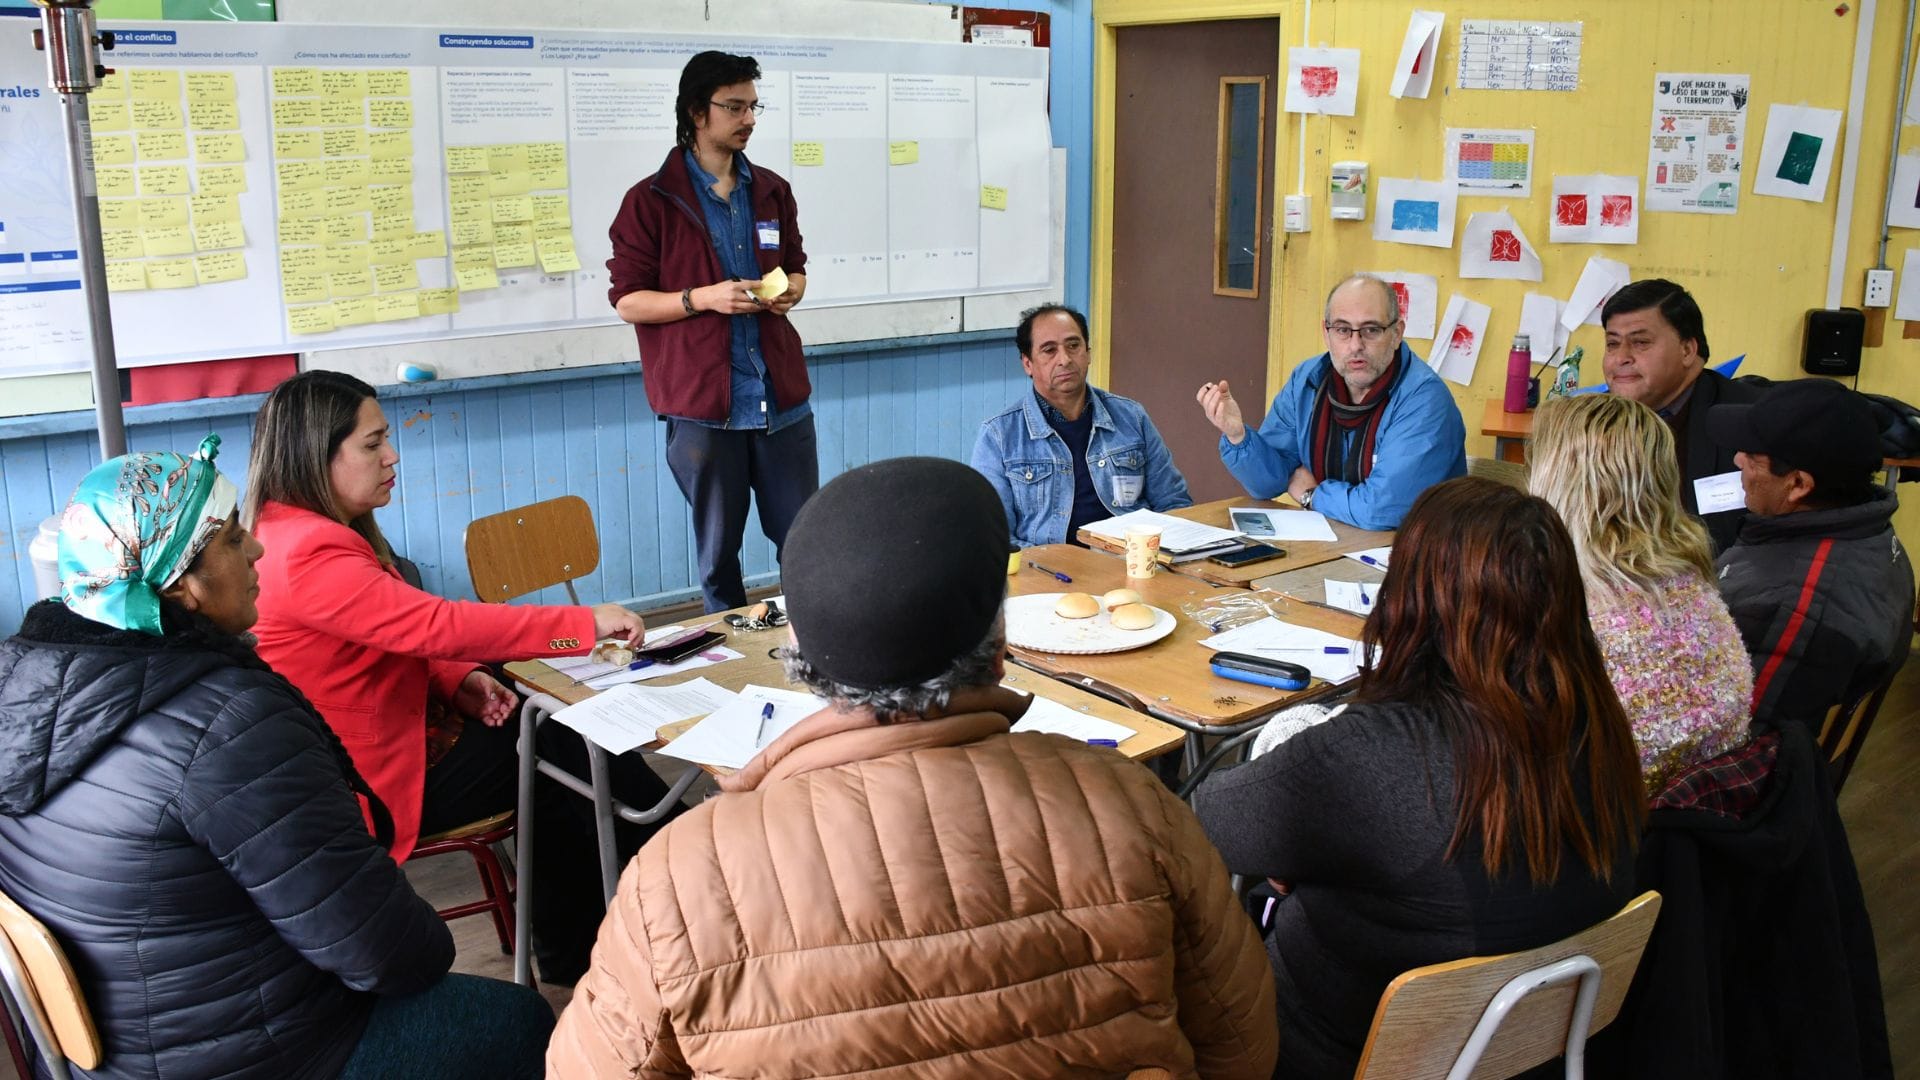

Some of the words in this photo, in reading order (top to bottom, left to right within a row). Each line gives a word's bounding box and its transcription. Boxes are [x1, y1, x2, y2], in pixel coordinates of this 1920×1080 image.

[125, 33, 133, 43] el
[135, 33, 173, 44] conflicto
[444, 37, 493, 47] Construyendo
[117, 51, 150, 59] referimos
[152, 51, 177, 59] cuando
[179, 51, 212, 59] hablamos
[214, 51, 223, 59] del
[225, 51, 258, 60] conflicto?
[1695, 81, 1716, 89] HACER
[1717, 81, 1727, 89] EN
[1672, 88, 1689, 97] CASO
[1711, 89, 1730, 97] SISMO
[1684, 96, 1725, 105] TERREMOTO?
